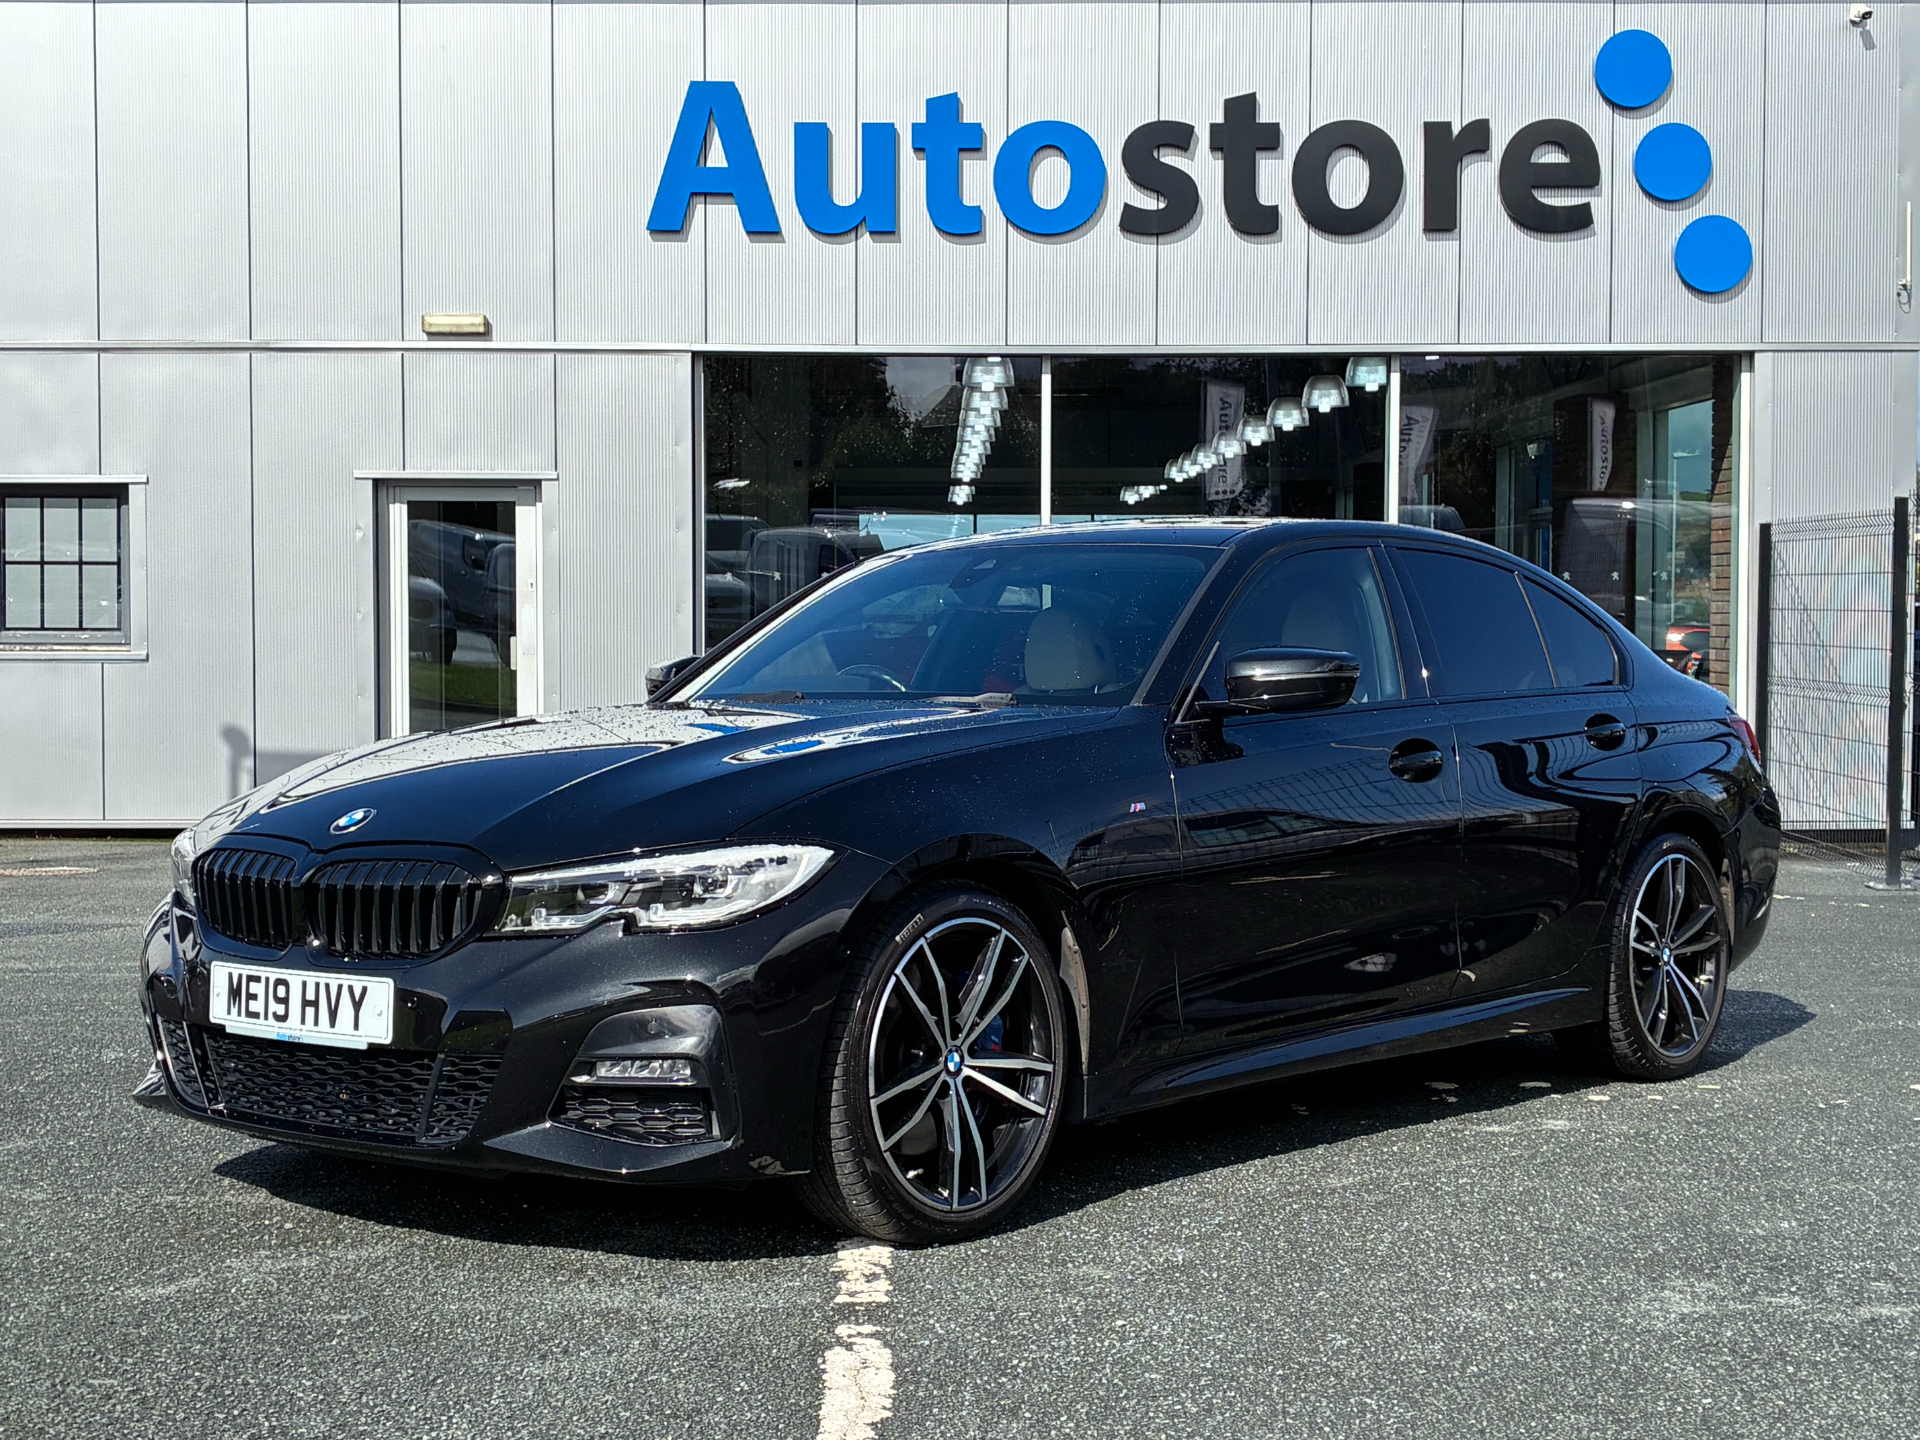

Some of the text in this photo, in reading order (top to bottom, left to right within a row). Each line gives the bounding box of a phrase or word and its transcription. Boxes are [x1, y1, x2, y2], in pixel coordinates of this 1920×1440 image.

[647, 80, 1601, 235] Autostore
[226, 971, 368, 1031] ME19 HVY
